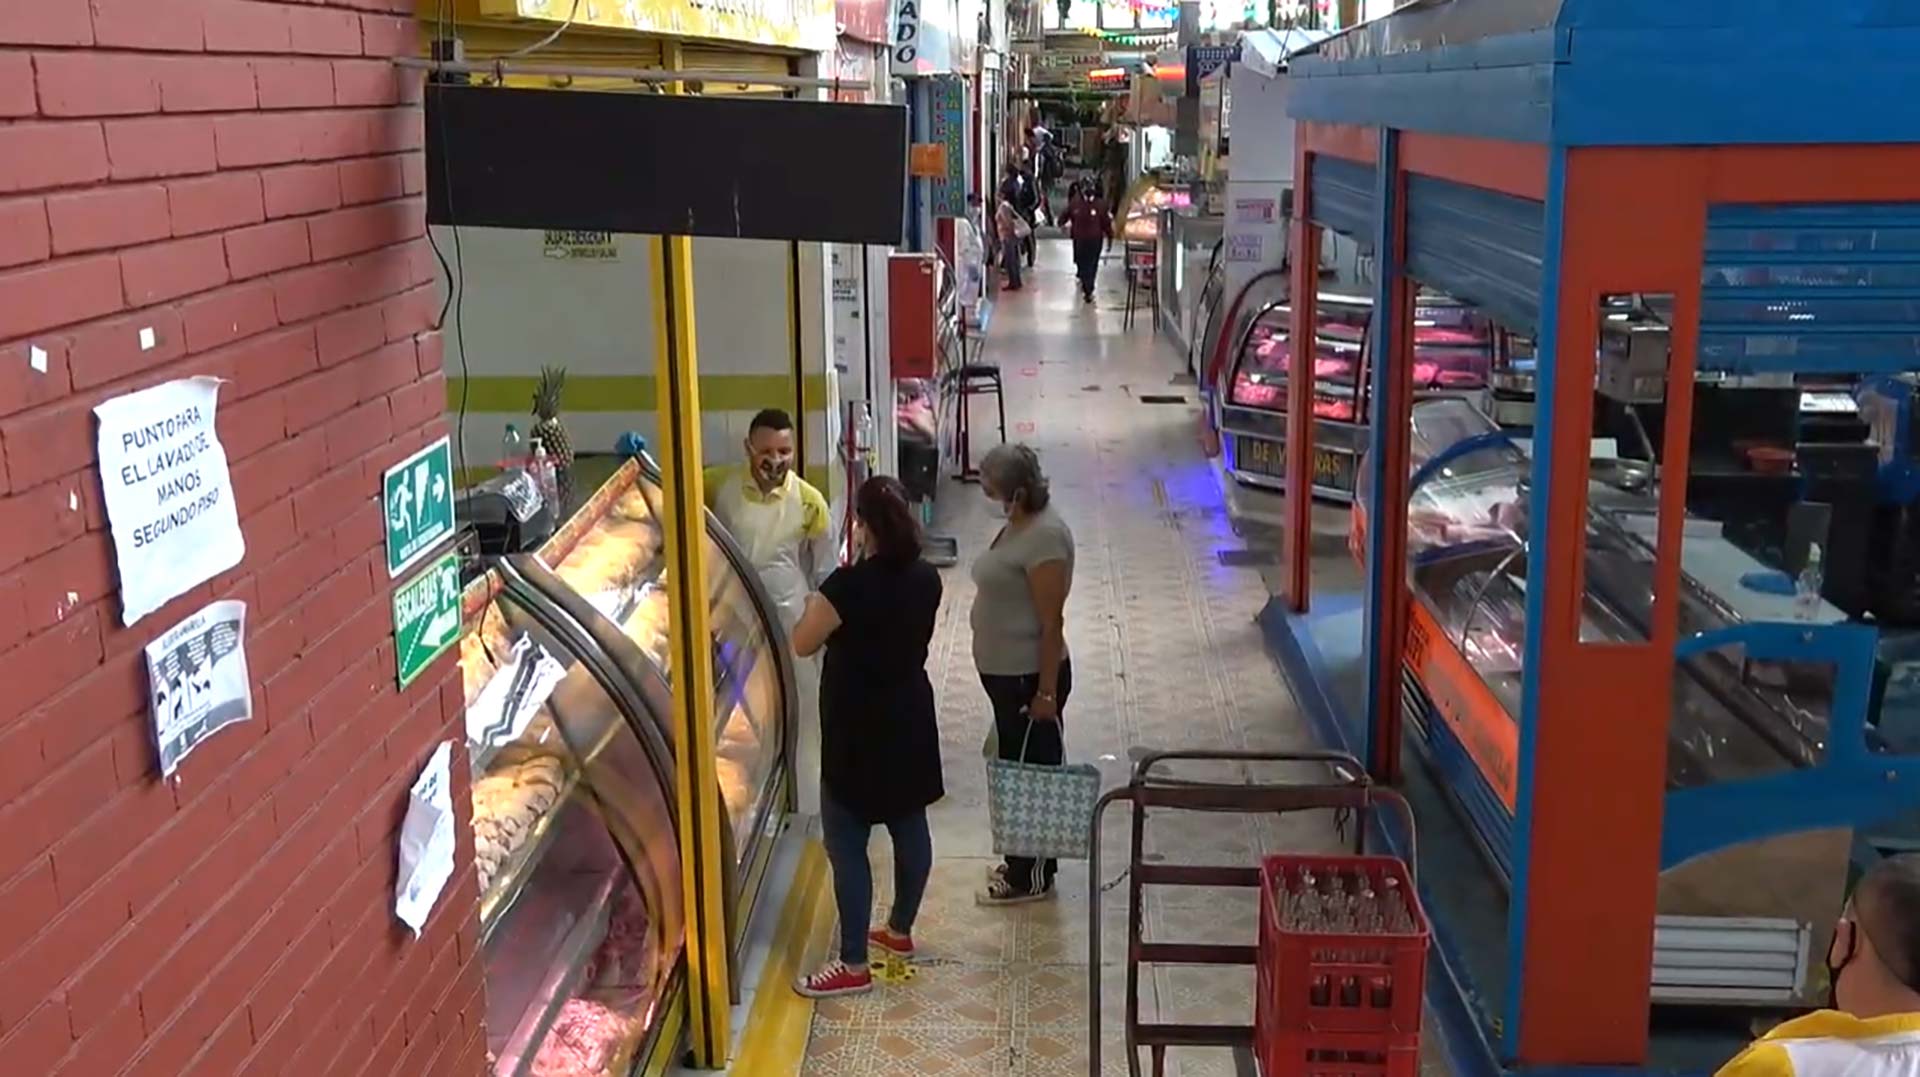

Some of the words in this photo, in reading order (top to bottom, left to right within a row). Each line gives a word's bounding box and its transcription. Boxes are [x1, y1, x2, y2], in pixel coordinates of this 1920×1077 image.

[122, 418, 175, 453] PUNTO
[175, 405, 203, 433] PARA
[121, 464, 148, 486] EL
[147, 438, 196, 477] LAVADO
[195, 431, 211, 454] DE
[156, 468, 202, 506] MANOS
[133, 501, 196, 548] SEGUNDO
[196, 486, 220, 515] PISO
[396, 568, 438, 633] ESCALERAS
